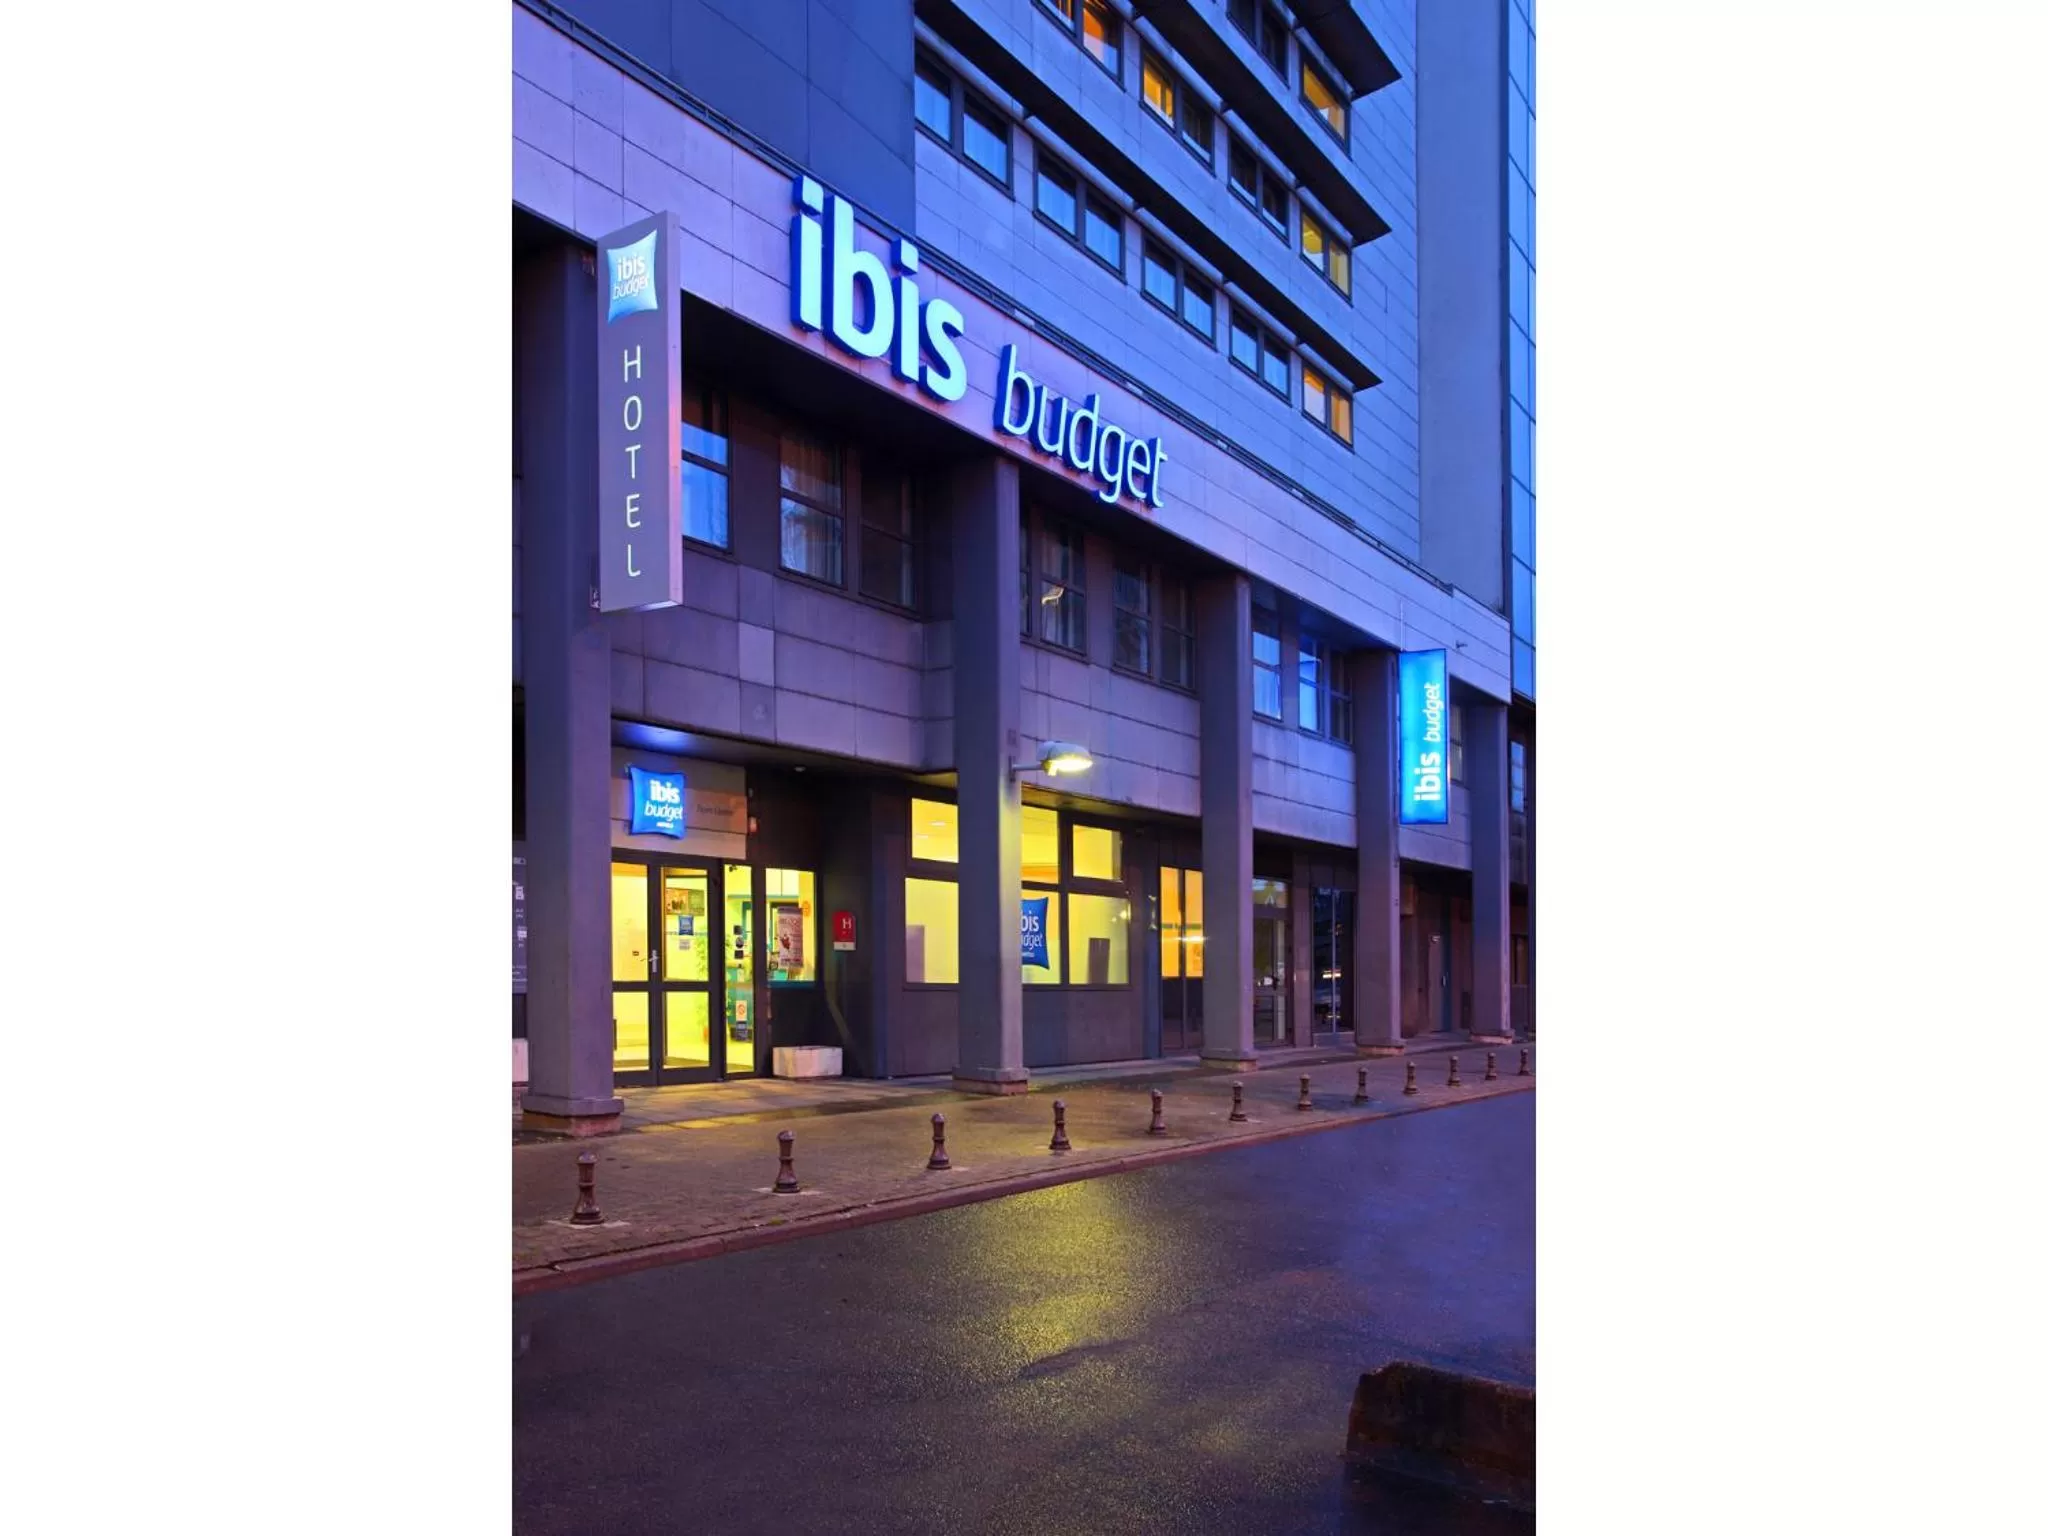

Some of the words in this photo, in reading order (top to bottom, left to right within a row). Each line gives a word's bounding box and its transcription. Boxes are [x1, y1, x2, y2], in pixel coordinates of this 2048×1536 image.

[617, 254, 645, 282] ibis
[612, 274, 649, 300] budget
[791, 175, 967, 401] ibis
[994, 344, 1168, 508] budget
[623, 344, 642, 578] HOTEL
[1423, 682, 1444, 743] budget
[1413, 751, 1441, 801] ibis
[650, 779, 680, 804] ibis
[644, 800, 683, 821] budget
[842, 918, 852, 929] H
[1021, 909, 1039, 932] bis
